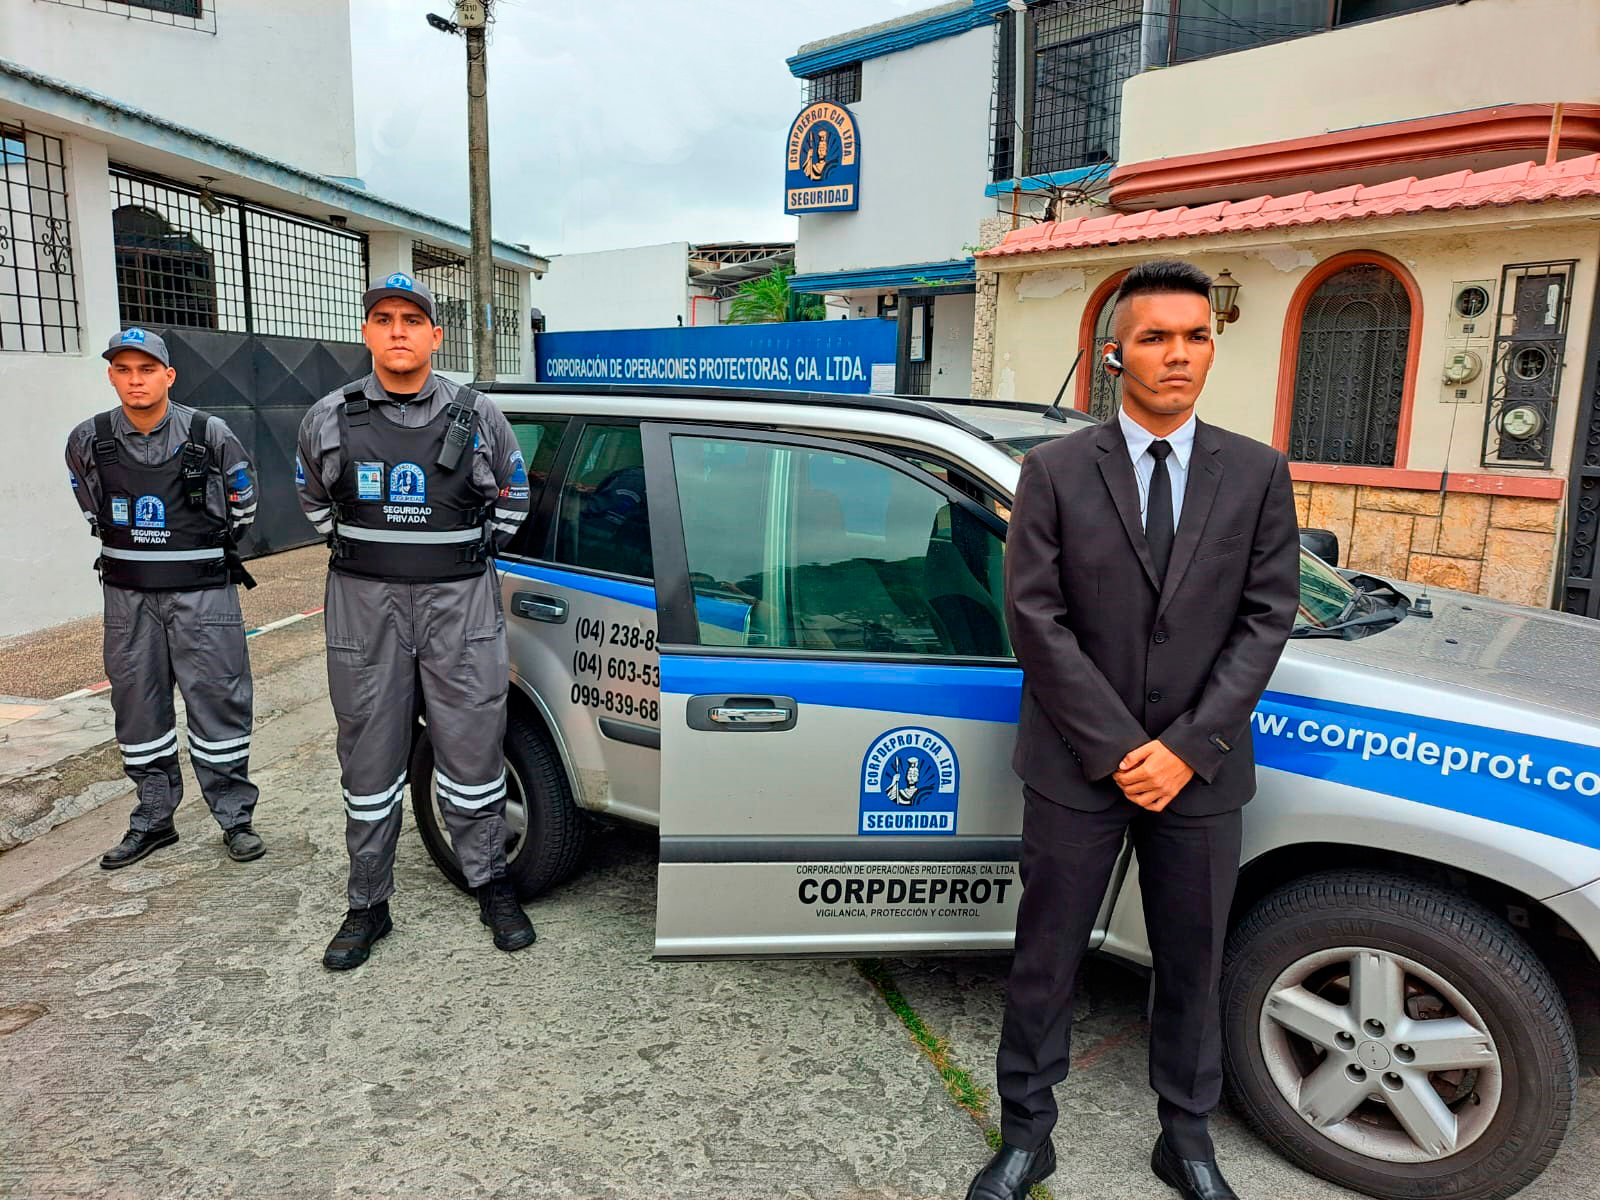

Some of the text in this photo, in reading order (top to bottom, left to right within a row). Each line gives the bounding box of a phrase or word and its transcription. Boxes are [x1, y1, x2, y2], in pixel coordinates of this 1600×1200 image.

[790, 107, 829, 163] CORPDEPROT
[791, 188, 849, 206] SEGURIDAD
[546, 353, 608, 377] CORPORACIÓN
[610, 358, 622, 378] DE
[624, 357, 697, 379] OPERACIONES
[699, 356, 792, 384] PROTECTORAS,
[795, 356, 822, 381] CIA.
[825, 355, 867, 381] LTDA.
[383, 505, 432, 515] SEGURIDAD
[386, 514, 427, 524] PRIVADA
[131, 529, 171, 537] SEGURIDAD
[133, 536, 167, 544] PRIVADA
[575, 617, 660, 653] (04) 238-8
[573, 650, 660, 688] (04) 603-53
[571, 683, 658, 721] 099-839-68
[867, 733, 921, 786] CORPDEPROT
[1250, 711, 1600, 797] w.corpdeprot.co
[867, 814, 949, 829] SEGURIDAD
[854, 865, 864, 875] DE
[866, 865, 920, 875] OPERACIONES
[921, 865, 977, 876] PROTECTORAS,
[996, 865, 1016, 875] LTDA.
[798, 878, 1013, 905] CORPDEPROT
[815, 907, 980, 918] VIGILANCIA, PROTECCIÓN Y CONTROL
